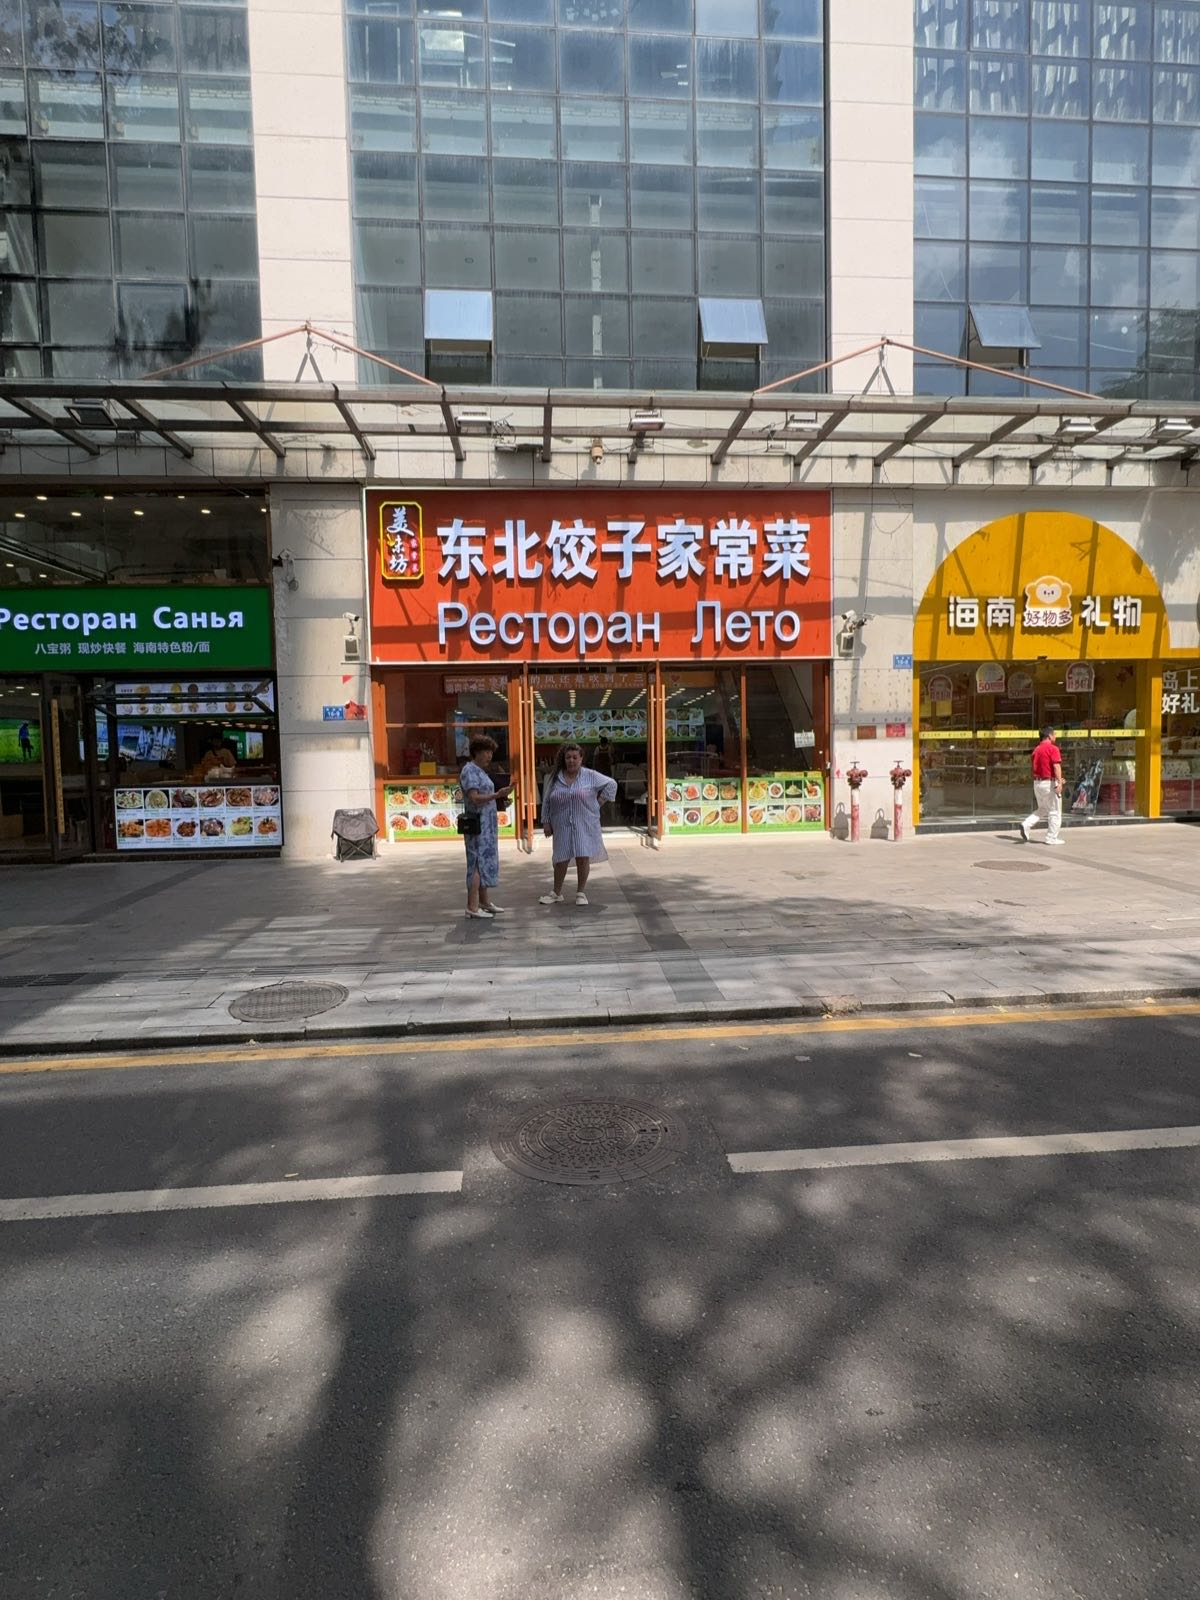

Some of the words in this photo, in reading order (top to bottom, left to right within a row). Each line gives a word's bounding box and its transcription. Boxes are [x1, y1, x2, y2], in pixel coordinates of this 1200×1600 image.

[437, 518, 811, 580] 东北饺子家常菜
[0, 607, 137, 635] Ресторан
[153, 606, 244, 629] Санья
[949, 596, 1016, 627] 海南
[1081, 596, 1142, 627] 礼物
[1025, 610, 1071, 625] 好物多
[438, 602, 660, 654] Ресторан
[691, 601, 801, 643] Лето
[35, 643, 71, 655] 八宝粥
[78, 642, 126, 655] 现炒快餐
[133, 641, 210, 654] 海南特色粉/面
[1163, 670, 1199, 691] 岛上
[1161, 693, 1200, 714] 好礼
